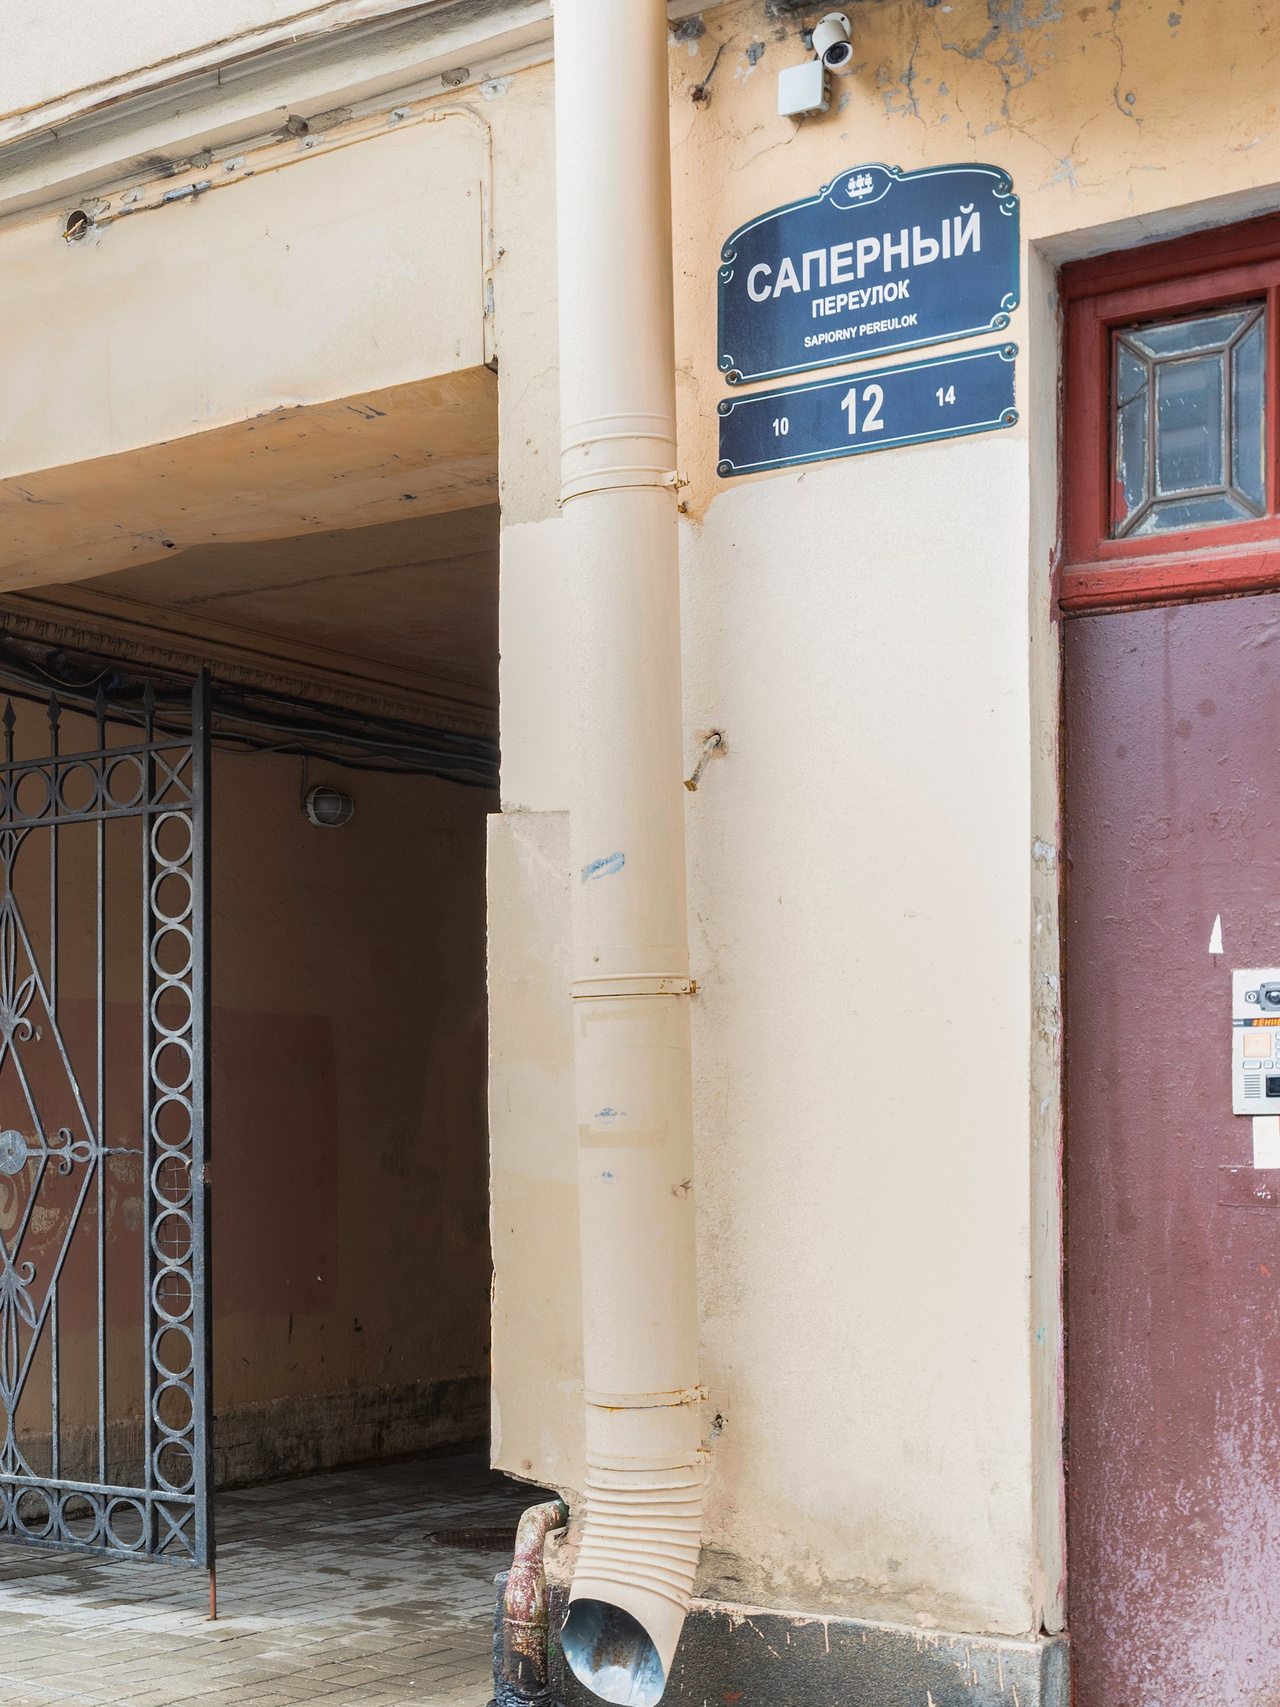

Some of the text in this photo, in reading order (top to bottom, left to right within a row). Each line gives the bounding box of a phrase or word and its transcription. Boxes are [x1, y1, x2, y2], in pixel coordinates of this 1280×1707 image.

[746, 202, 981, 303] САПЕРНЫЙ
[811, 278, 911, 319] ПЕРЕУЛОК
[803, 313, 918, 348] SAPIORNY PEREULOK
[772, 383, 956, 437] 10 12 14
